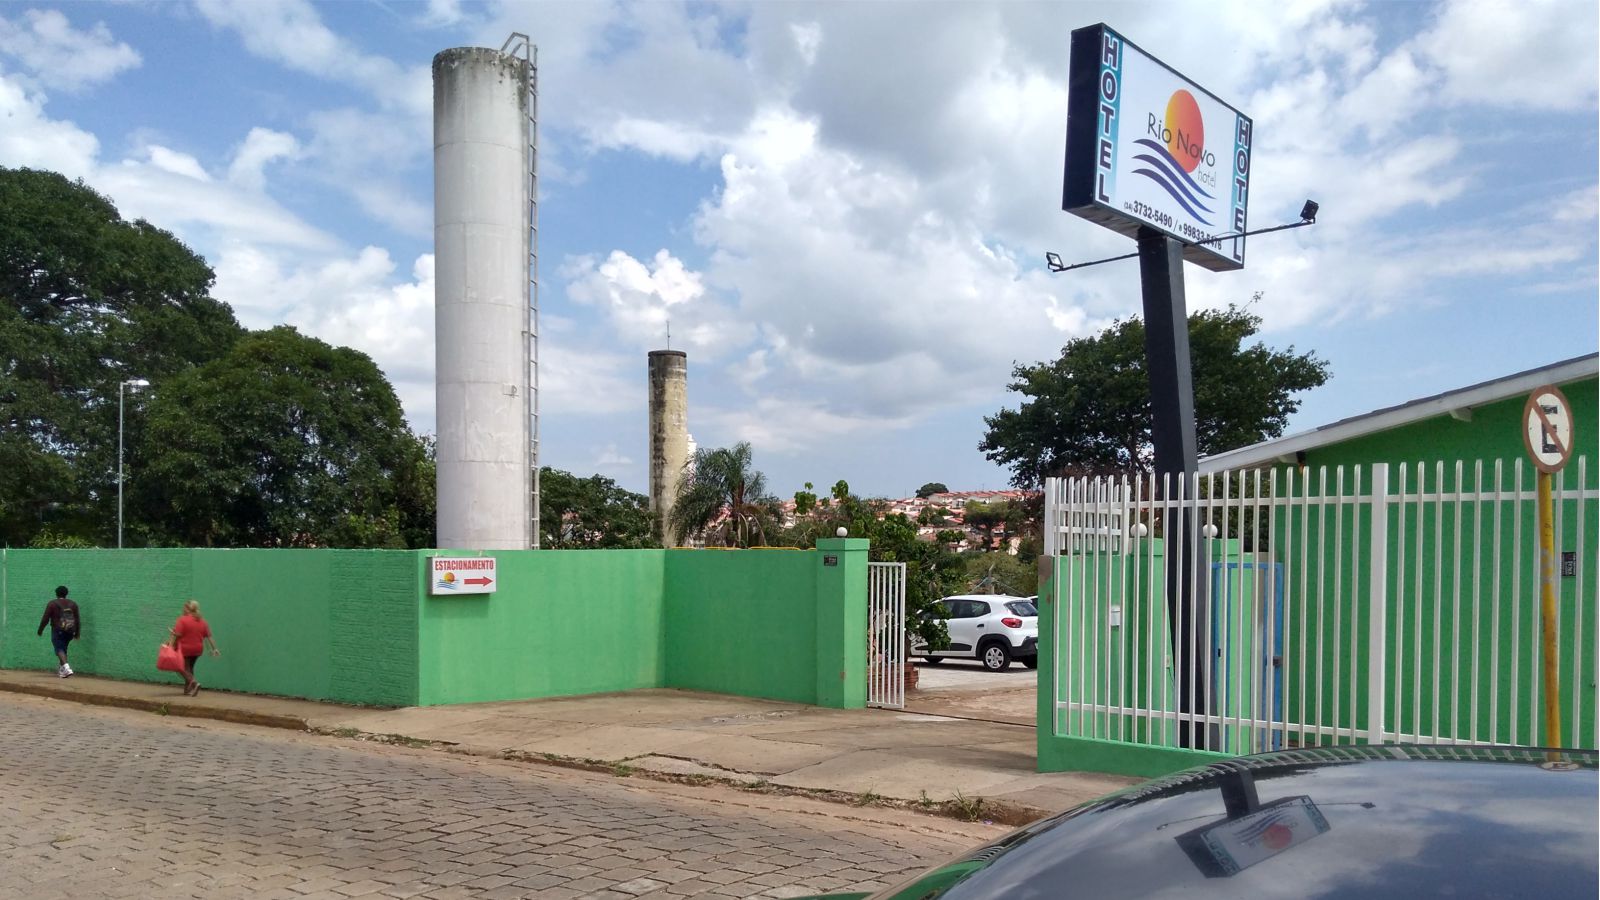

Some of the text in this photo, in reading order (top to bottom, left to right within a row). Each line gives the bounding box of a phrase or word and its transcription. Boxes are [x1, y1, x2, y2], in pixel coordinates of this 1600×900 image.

[1097, 32, 1120, 204] HOTEL
[1147, 111, 1216, 167] Rio Novo
[1197, 163, 1217, 188] hotel
[1233, 118, 1250, 261] HOTEL
[1133, 200, 1173, 228] 3732-5490
[434, 559, 494, 571] ESTACIONAMENTO
